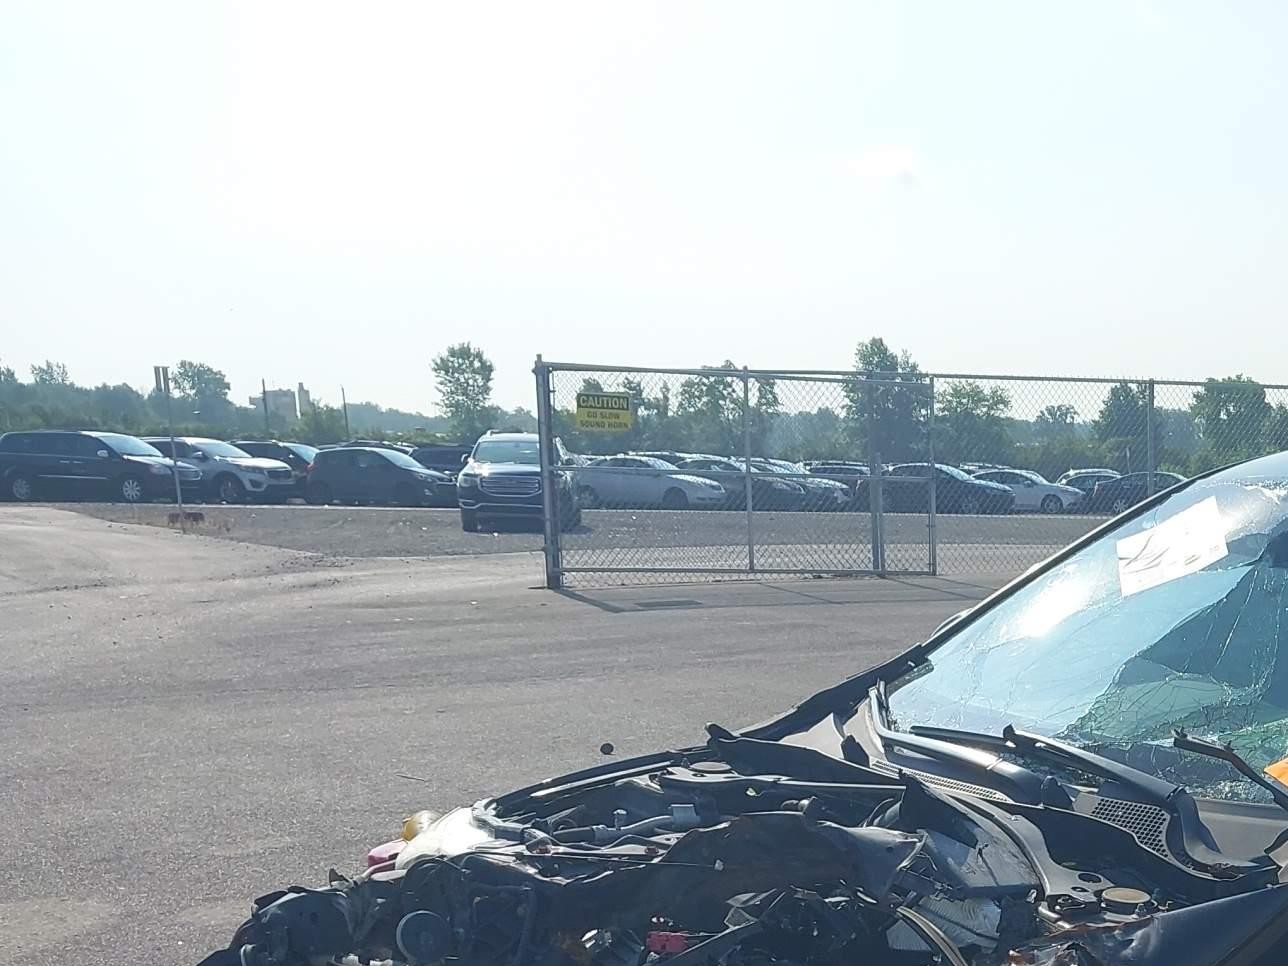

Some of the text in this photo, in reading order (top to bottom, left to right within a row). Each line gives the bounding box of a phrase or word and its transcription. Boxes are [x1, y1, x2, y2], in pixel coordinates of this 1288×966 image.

[580, 396, 627, 409] CAUTION
[600, 412, 620, 420] SLOW
[580, 420, 629, 429] SOUND HORN
